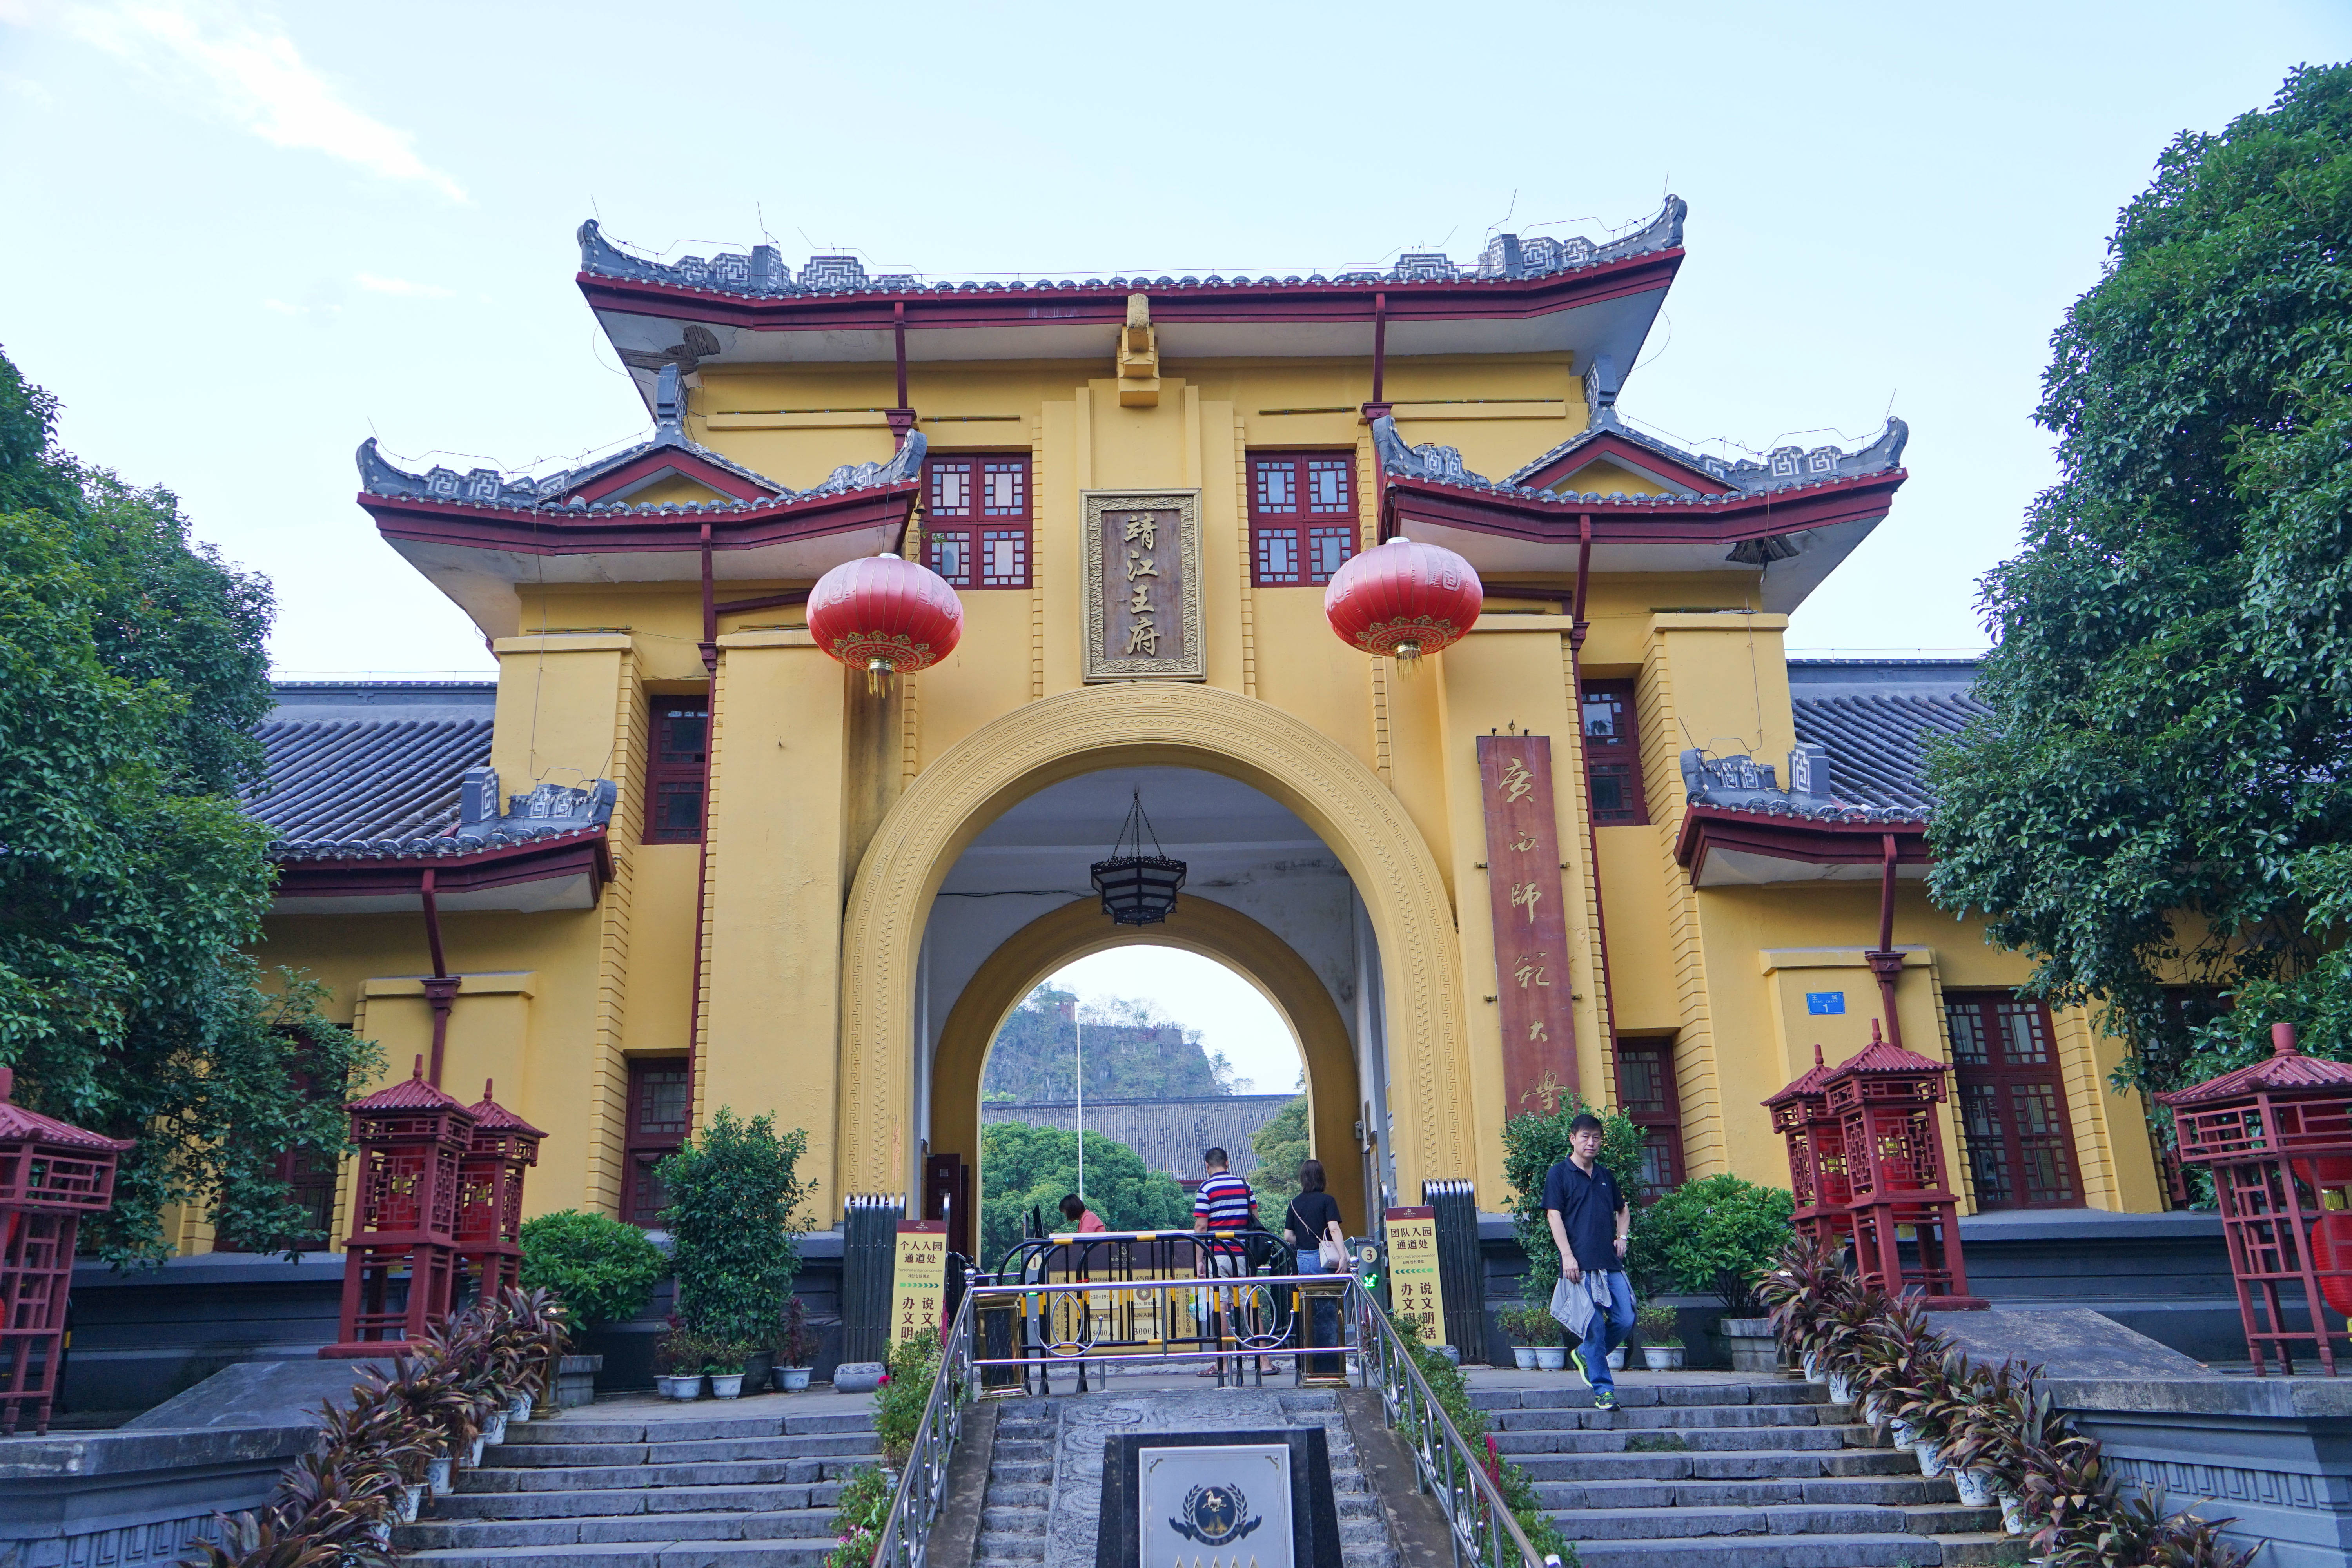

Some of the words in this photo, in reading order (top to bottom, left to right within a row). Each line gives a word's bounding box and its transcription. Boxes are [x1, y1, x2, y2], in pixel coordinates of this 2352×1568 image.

[1124, 513, 1160, 657] 靖江王府
[1823, 1004, 1828, 1012] 1
[1390, 1227, 1432, 1238] 团队入园
[900, 1241, 942, 1251] 个人入园
[1397, 1239, 1428, 1250] 通道处
[904, 1253, 936, 1263] 通道处
[1366, 1249, 1373, 1261] 3
[1033, 1257, 1037, 1268] 1
[1420, 1282, 1436, 1339] 说文明话
[901, 1297, 915, 1348] 办文明
